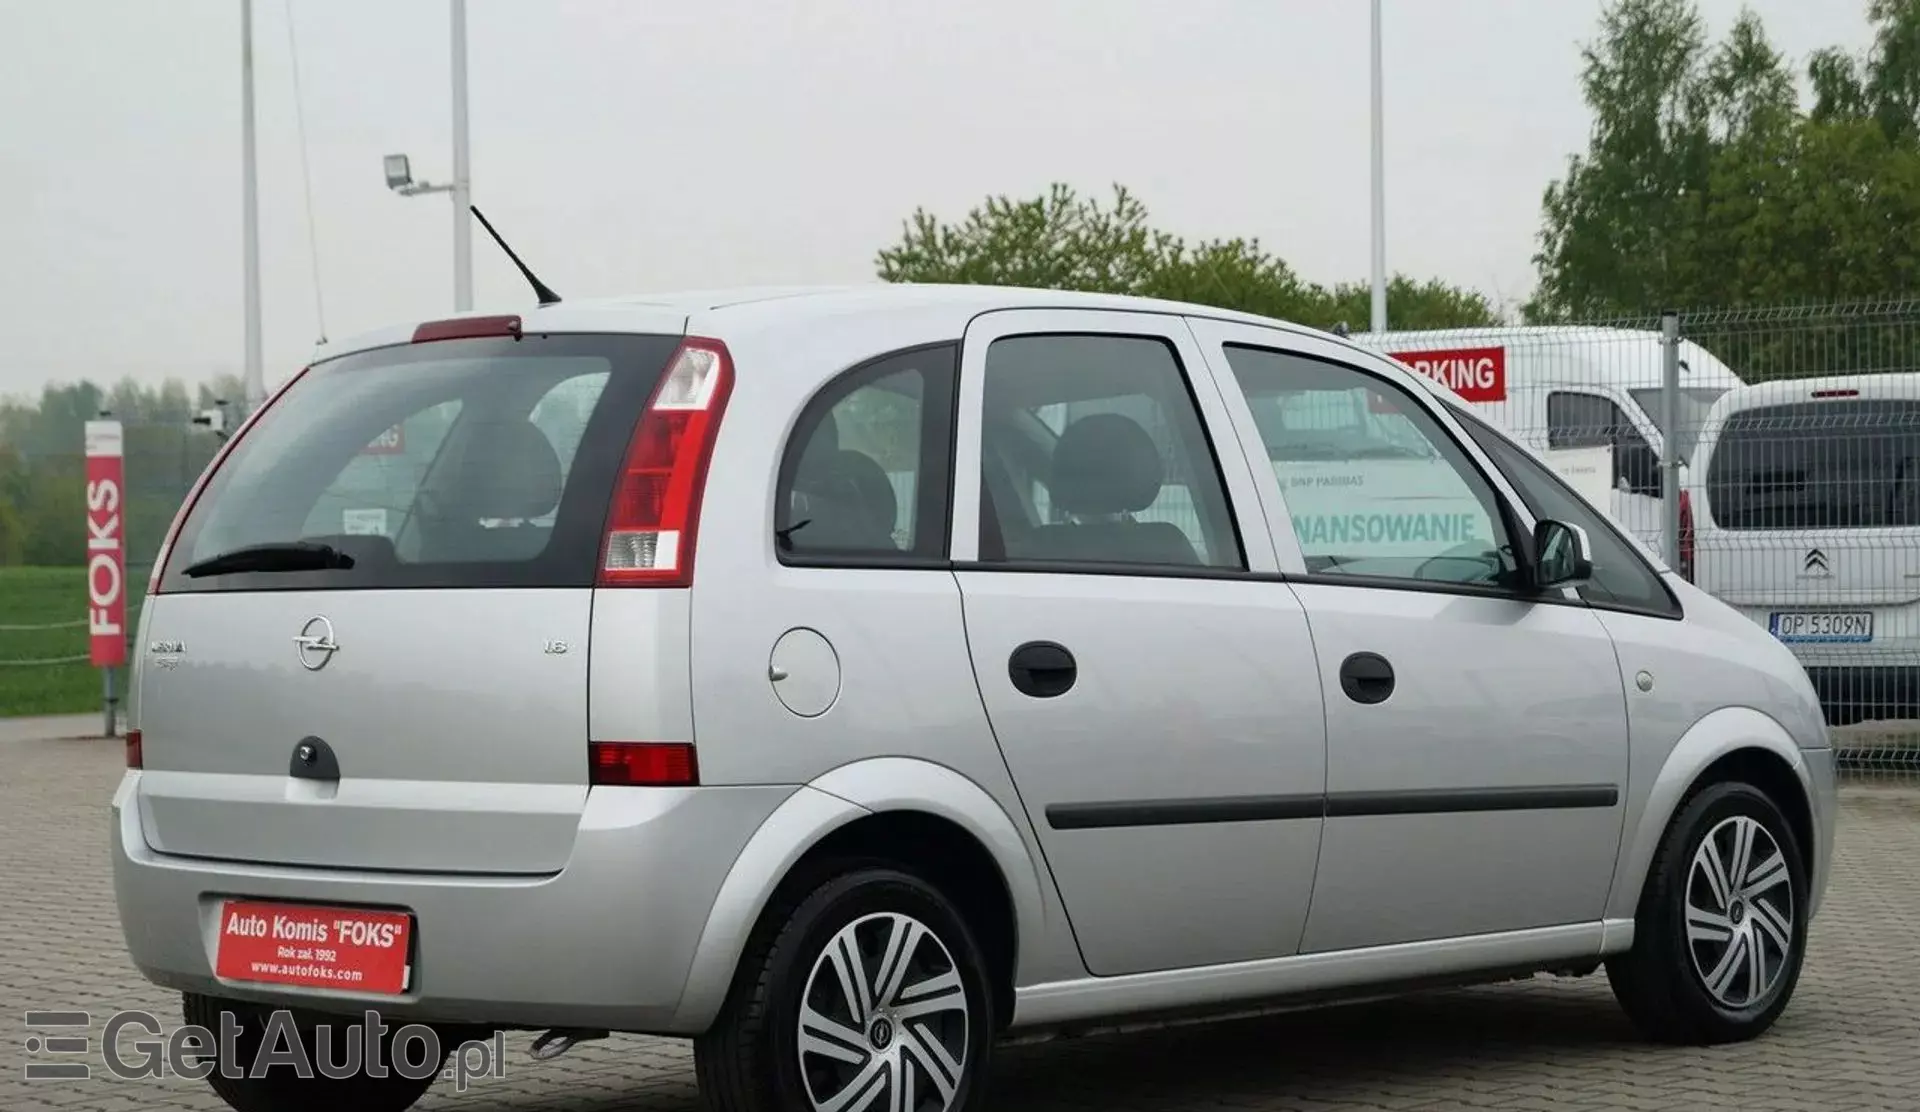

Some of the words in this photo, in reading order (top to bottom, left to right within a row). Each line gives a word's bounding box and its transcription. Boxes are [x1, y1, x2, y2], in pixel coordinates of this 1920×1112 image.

[1404, 357, 1495, 389] RKING
[87, 479, 121, 636] FOKS
[1782, 616, 1804, 635] OP
[1811, 615, 1867, 635] 5309N
[226, 912, 267, 938] Auto
[272, 915, 328, 943] Komis
[333, 919, 402, 948] "FOKS"
[277, 946, 295, 958] Rok
[315, 948, 337, 962] 1992
[251, 961, 363, 981] www.autofoks.com
